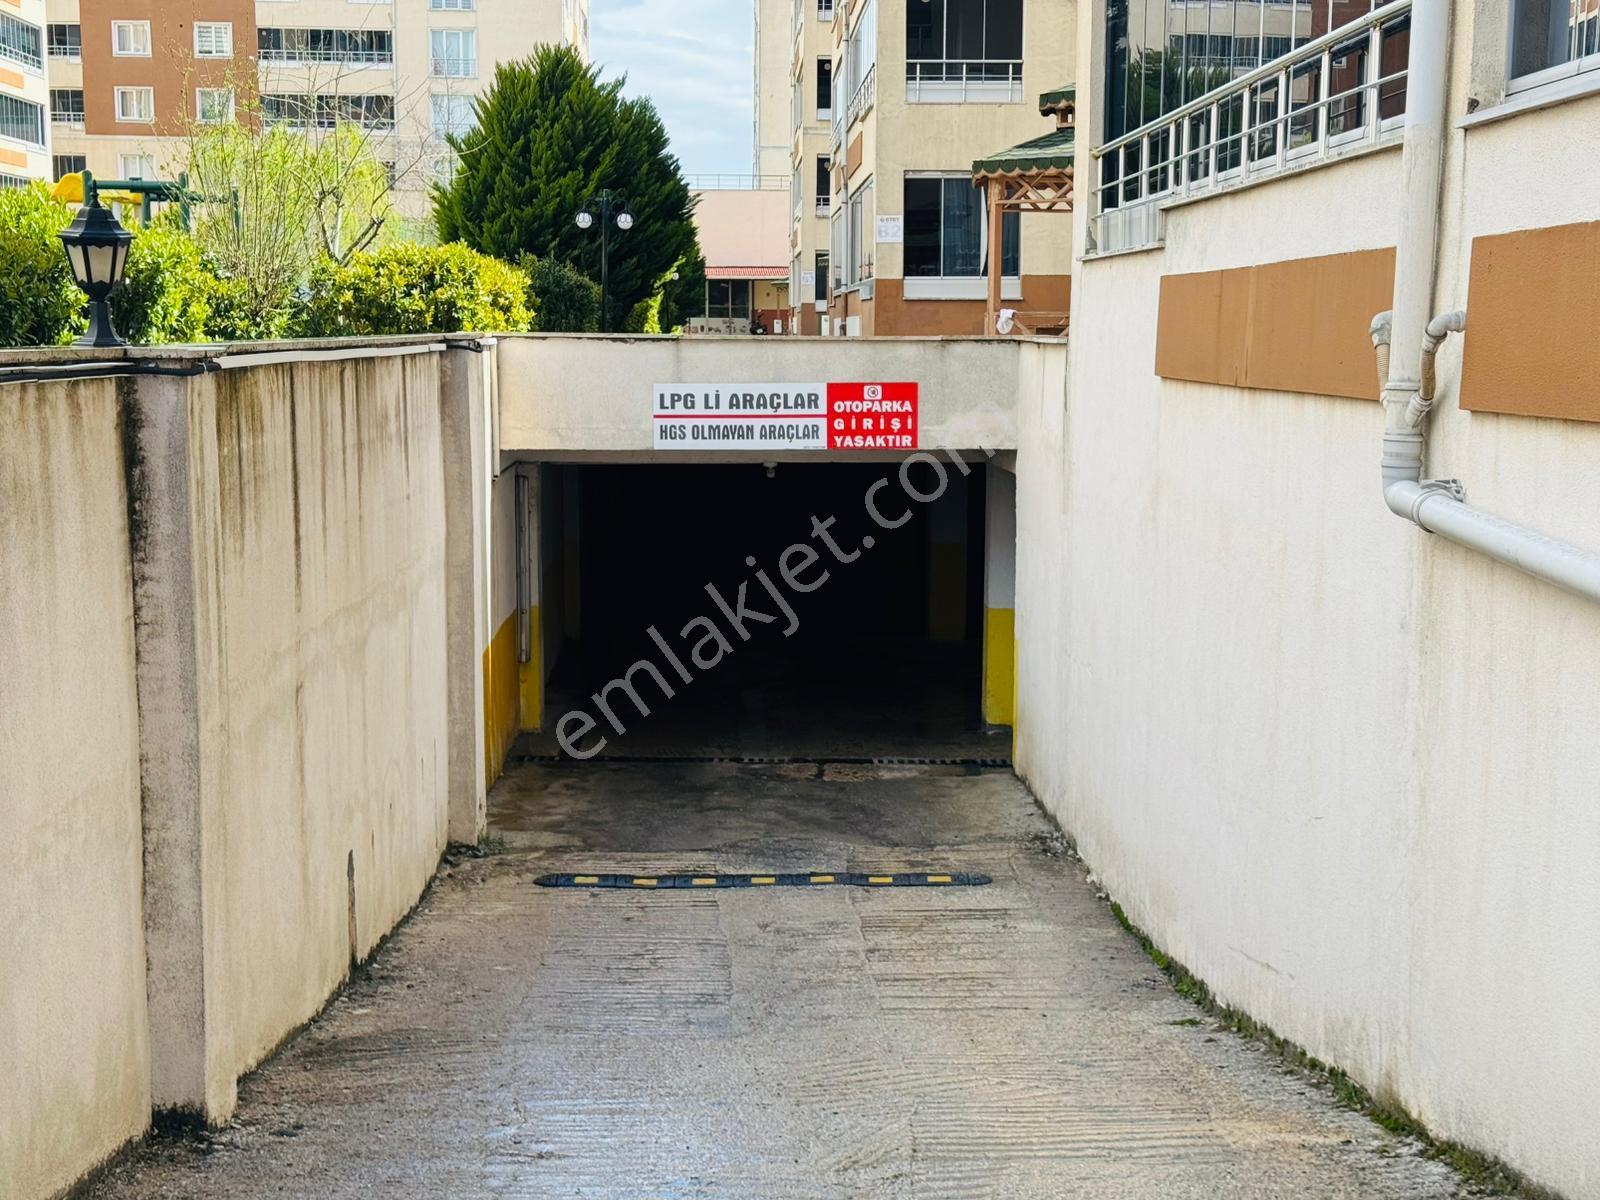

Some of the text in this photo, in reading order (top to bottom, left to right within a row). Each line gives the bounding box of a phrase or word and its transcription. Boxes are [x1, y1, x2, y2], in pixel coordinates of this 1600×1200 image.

[659, 393, 696, 410] LPG
[728, 393, 820, 413] ARAÇLAR
[833, 400, 912, 413] OTOPARKA
[833, 416, 913, 431] GİRİŞİ
[659, 424, 820, 443] HGS OLMAYAN ARAÇLAR
[833, 435, 912, 447] YASAKTIR
